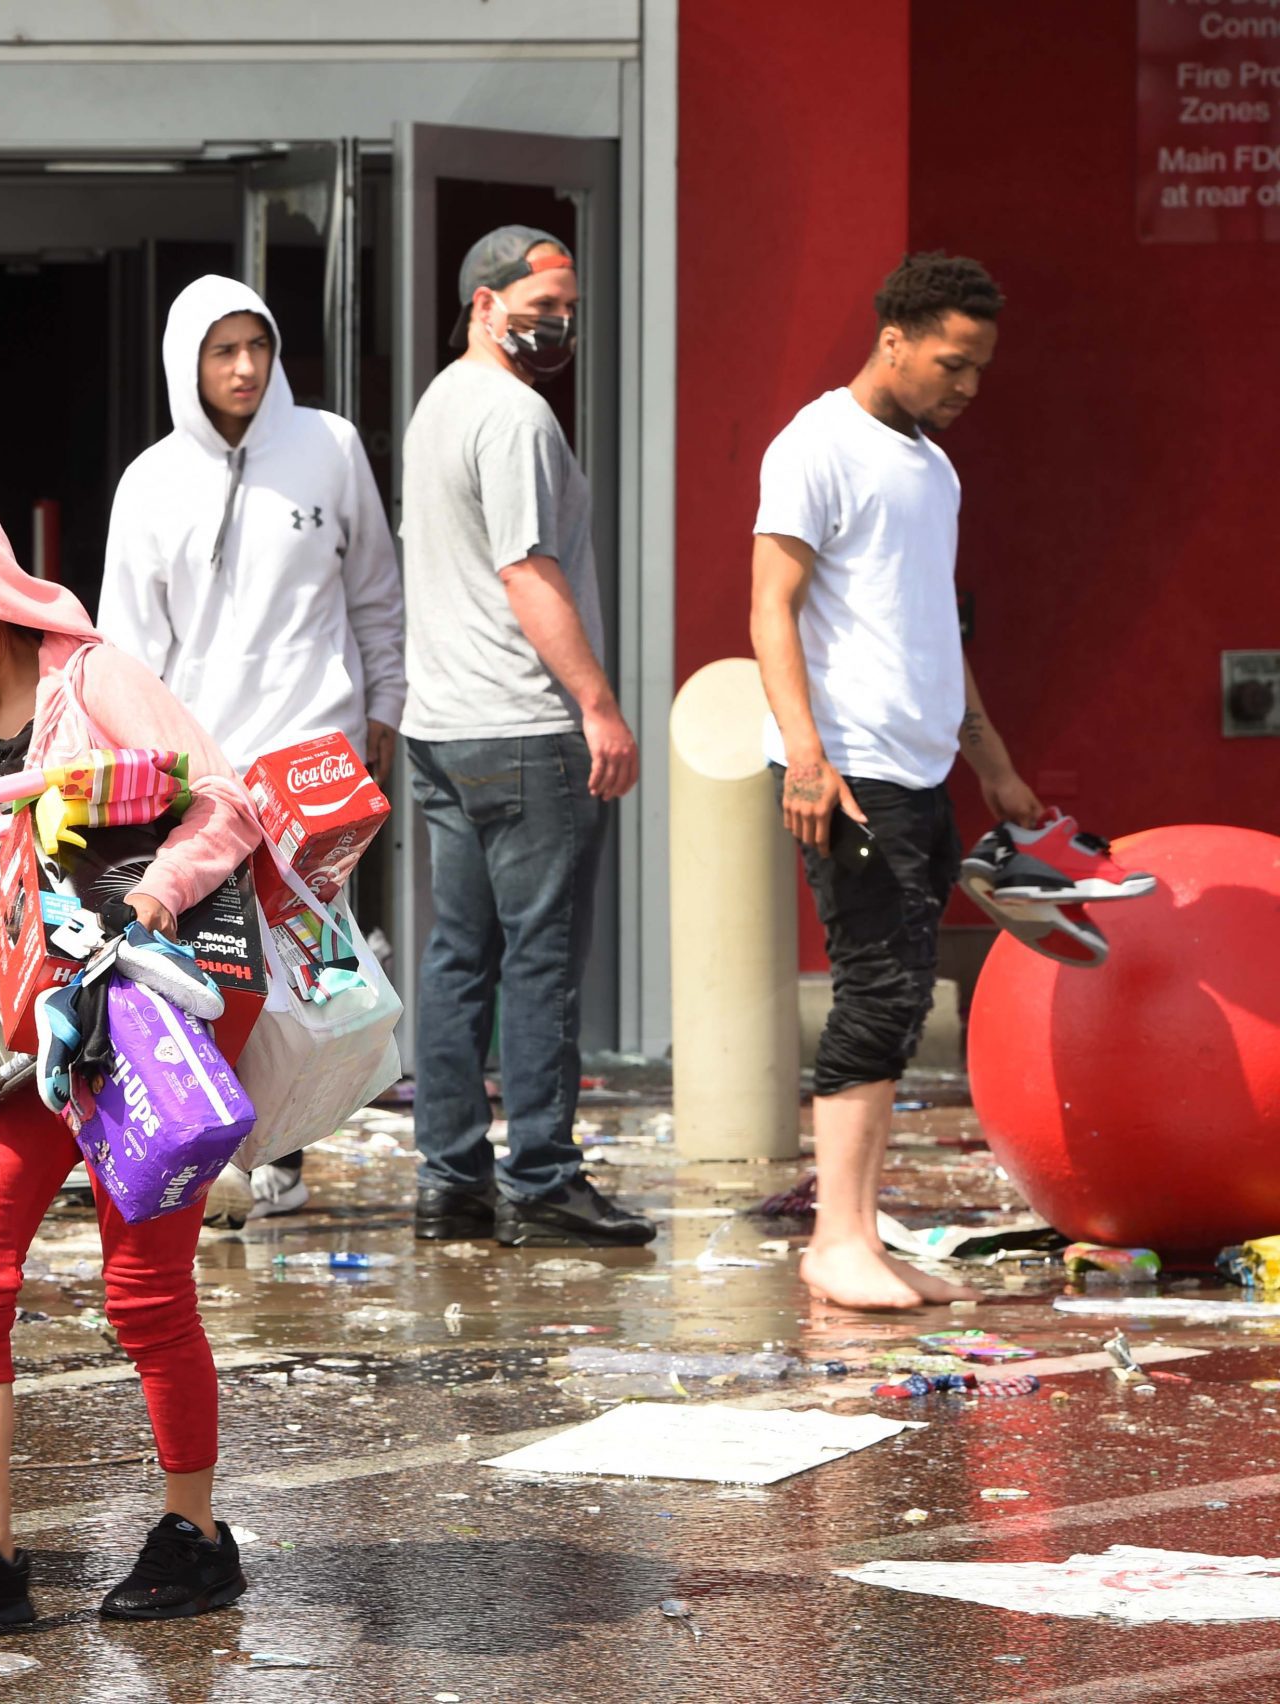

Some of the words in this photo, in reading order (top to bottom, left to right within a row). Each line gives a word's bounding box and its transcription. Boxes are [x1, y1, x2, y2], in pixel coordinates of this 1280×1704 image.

[1199, 12, 1280, 39] Conn
[1177, 62, 1232, 88] Fire
[1178, 96, 1270, 124] Zones
[1157, 149, 1227, 173] Main
[1161, 183, 1188, 208] at
[1195, 184, 1251, 207] rear
[286, 752, 356, 794] Coca-Cola
[175, 937, 248, 959] TurboForce
[195, 930, 247, 949] Power
